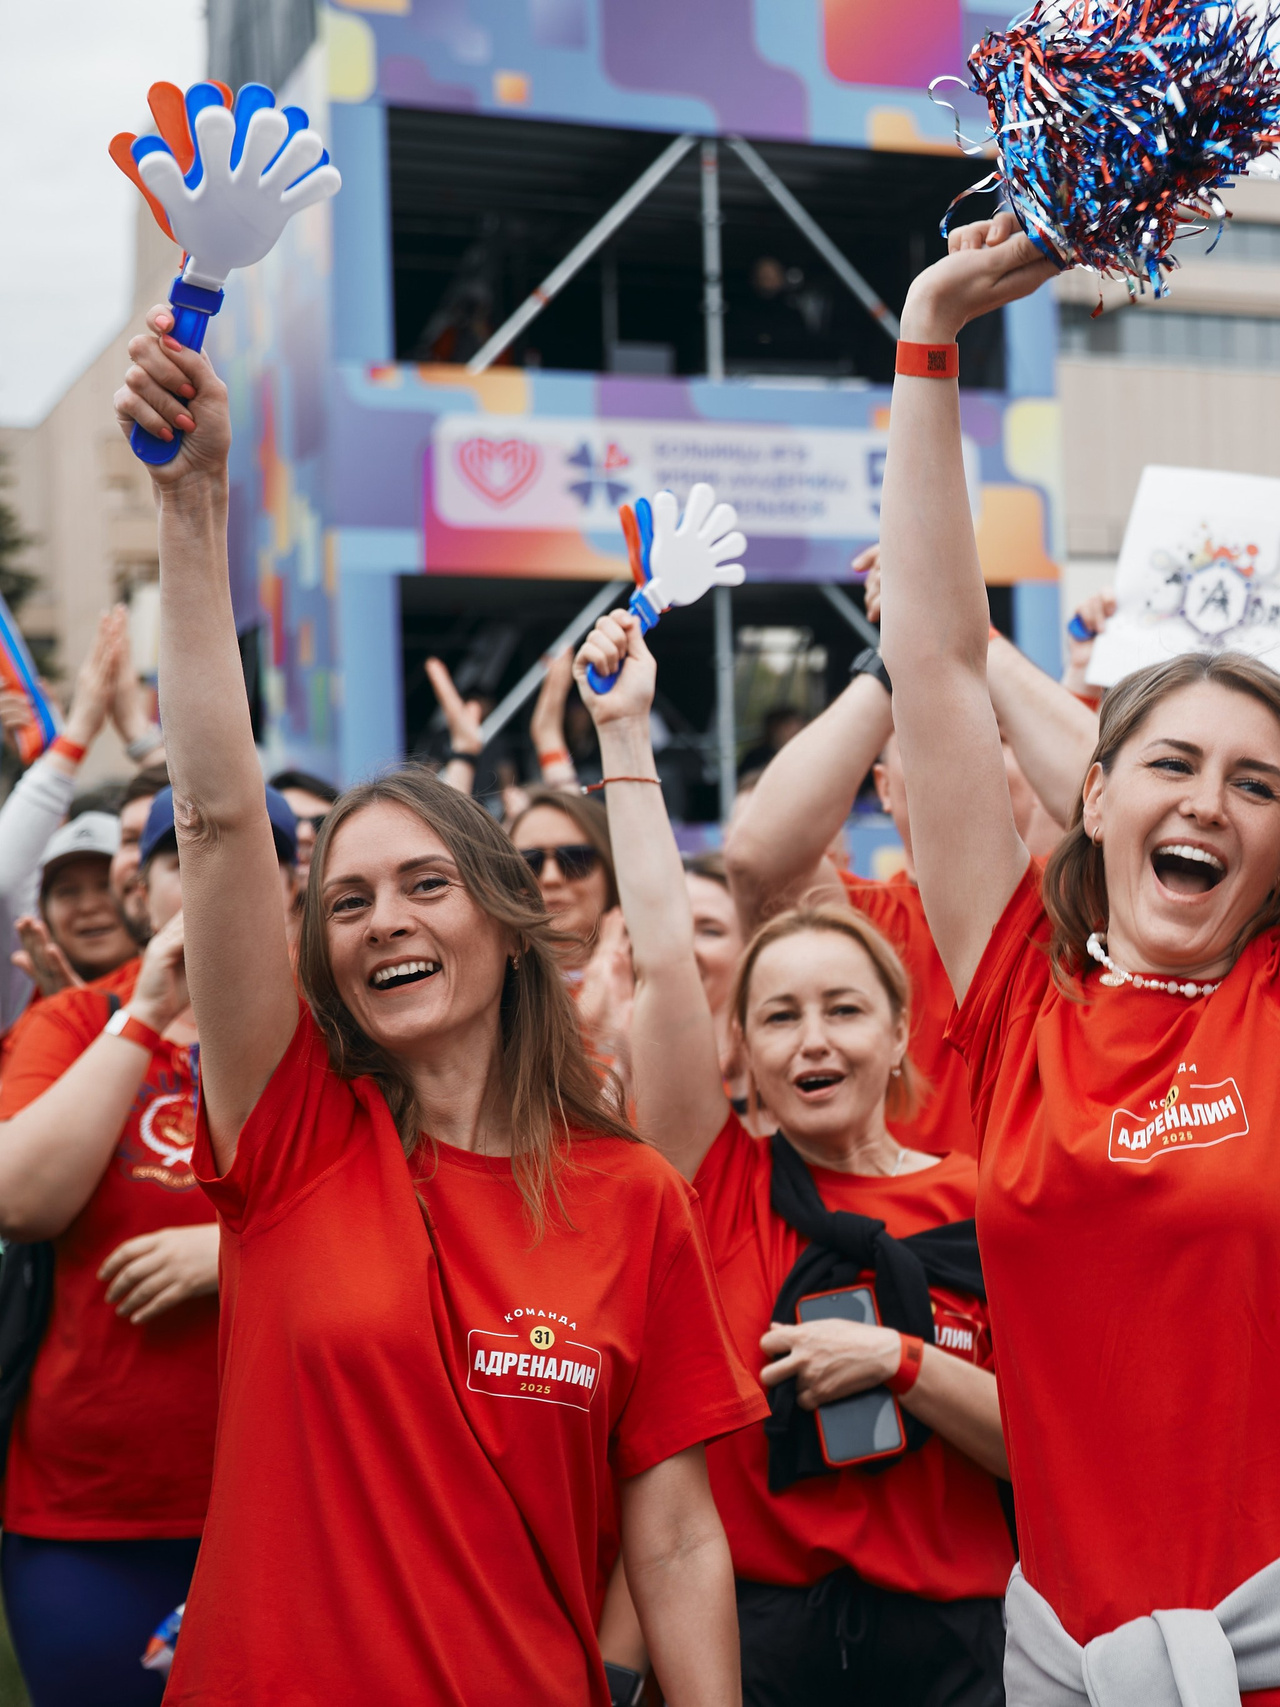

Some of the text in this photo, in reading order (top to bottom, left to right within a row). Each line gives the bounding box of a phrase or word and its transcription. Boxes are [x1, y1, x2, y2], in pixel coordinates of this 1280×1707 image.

[1117, 1095, 1237, 1151] АДРЕНАЛИН
[1162, 1131, 1193, 1145] 2025
[503, 1307, 577, 1331] КОМАНДА
[534, 1330, 550, 1345] 31
[473, 1350, 596, 1389] АДРЕНАЛИН
[519, 1382, 551, 1395] 2025
